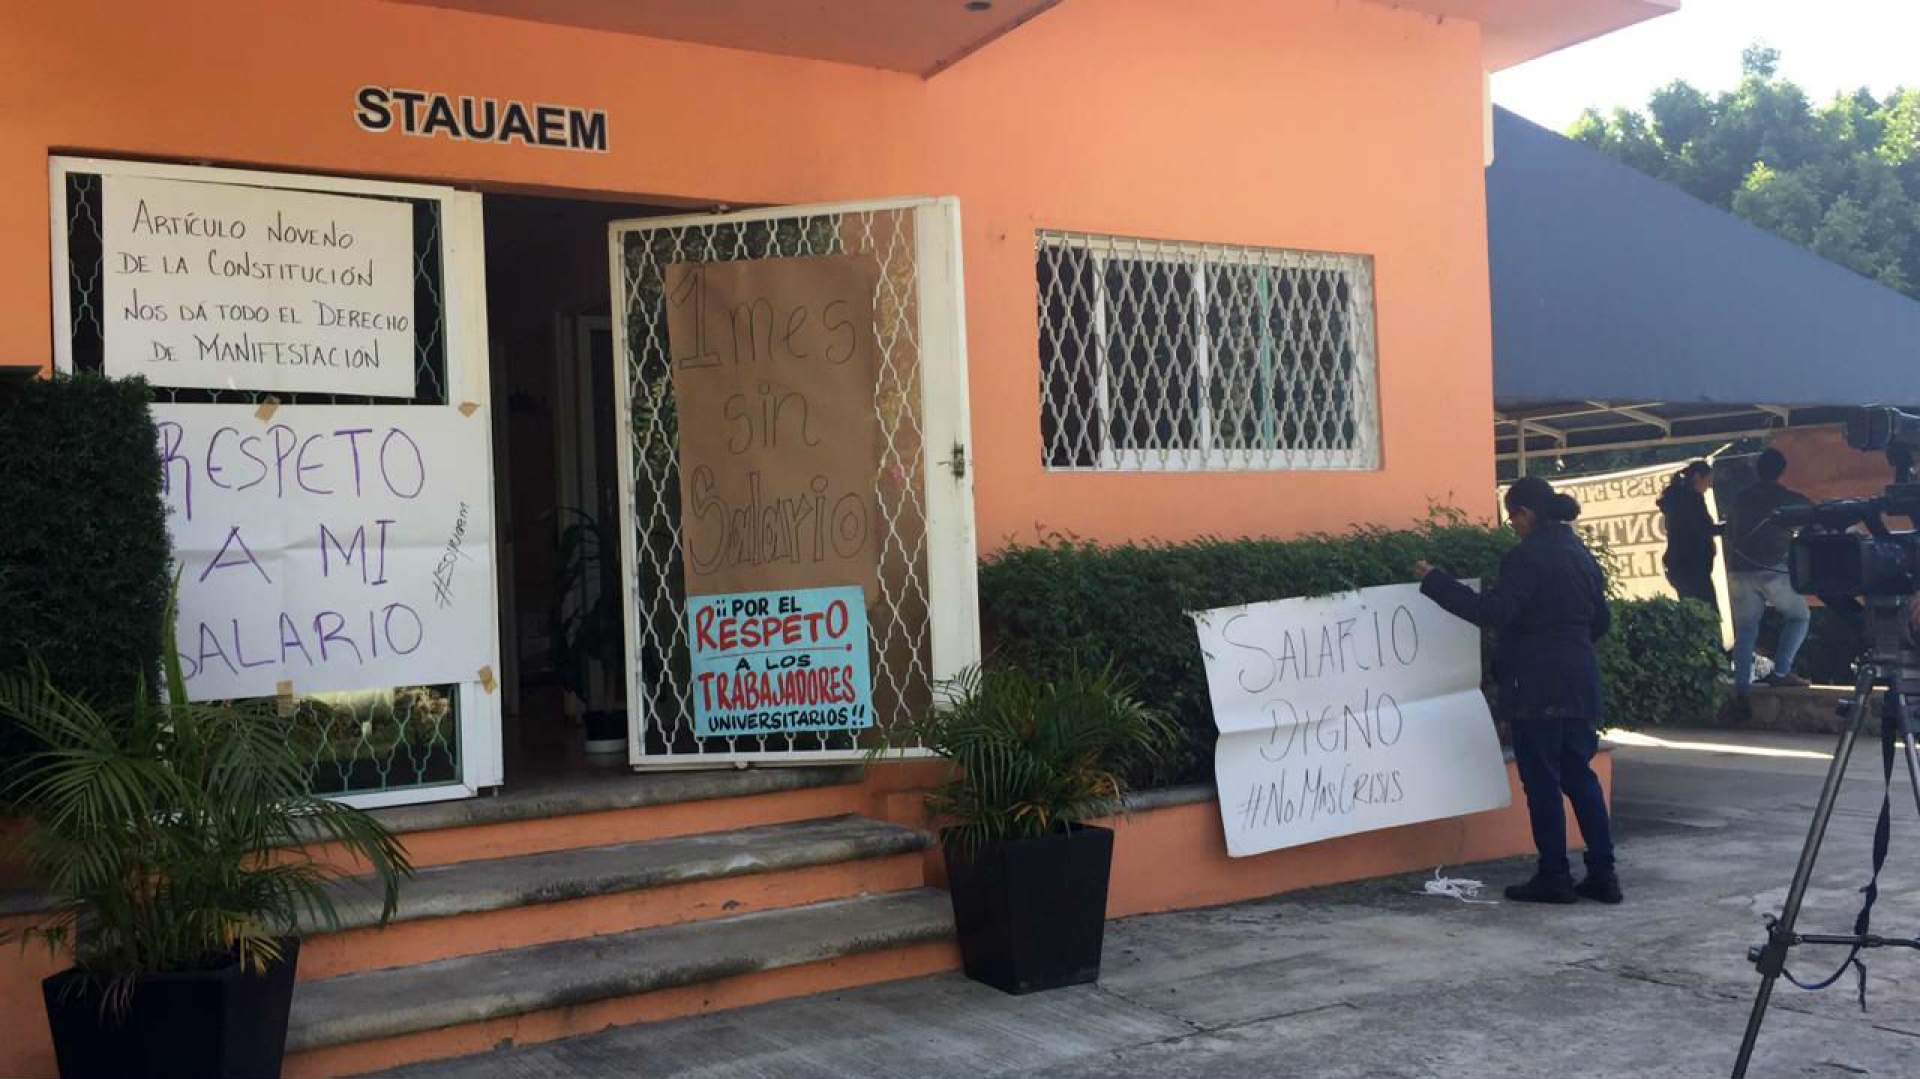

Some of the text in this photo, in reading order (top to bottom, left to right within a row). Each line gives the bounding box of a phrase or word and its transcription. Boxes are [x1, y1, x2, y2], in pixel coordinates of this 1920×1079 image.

[354, 86, 608, 152] STAUAEM
[115, 252, 152, 275] DE
[162, 255, 188, 275] LA
[124, 288, 168, 322] NOS
[219, 304, 270, 323] TODO
[279, 306, 302, 325] EL
[319, 300, 409, 333] DERECHO
[669, 265, 856, 370] 1 mes
[148, 340, 178, 362] DE
[724, 380, 822, 455] sin
[157, 421, 426, 521] RESPETO
[689, 464, 868, 576] Salario
[199, 519, 397, 585] A MI
[695, 600, 848, 653] RESPETO
[778, 596, 802, 613] EL
[697, 664, 856, 712] TRABAJADORES
[735, 654, 811, 671] A LOS
[708, 704, 865, 732] UNIVERSITARIOS!!
[1259, 687, 1403, 762] DIGNO
